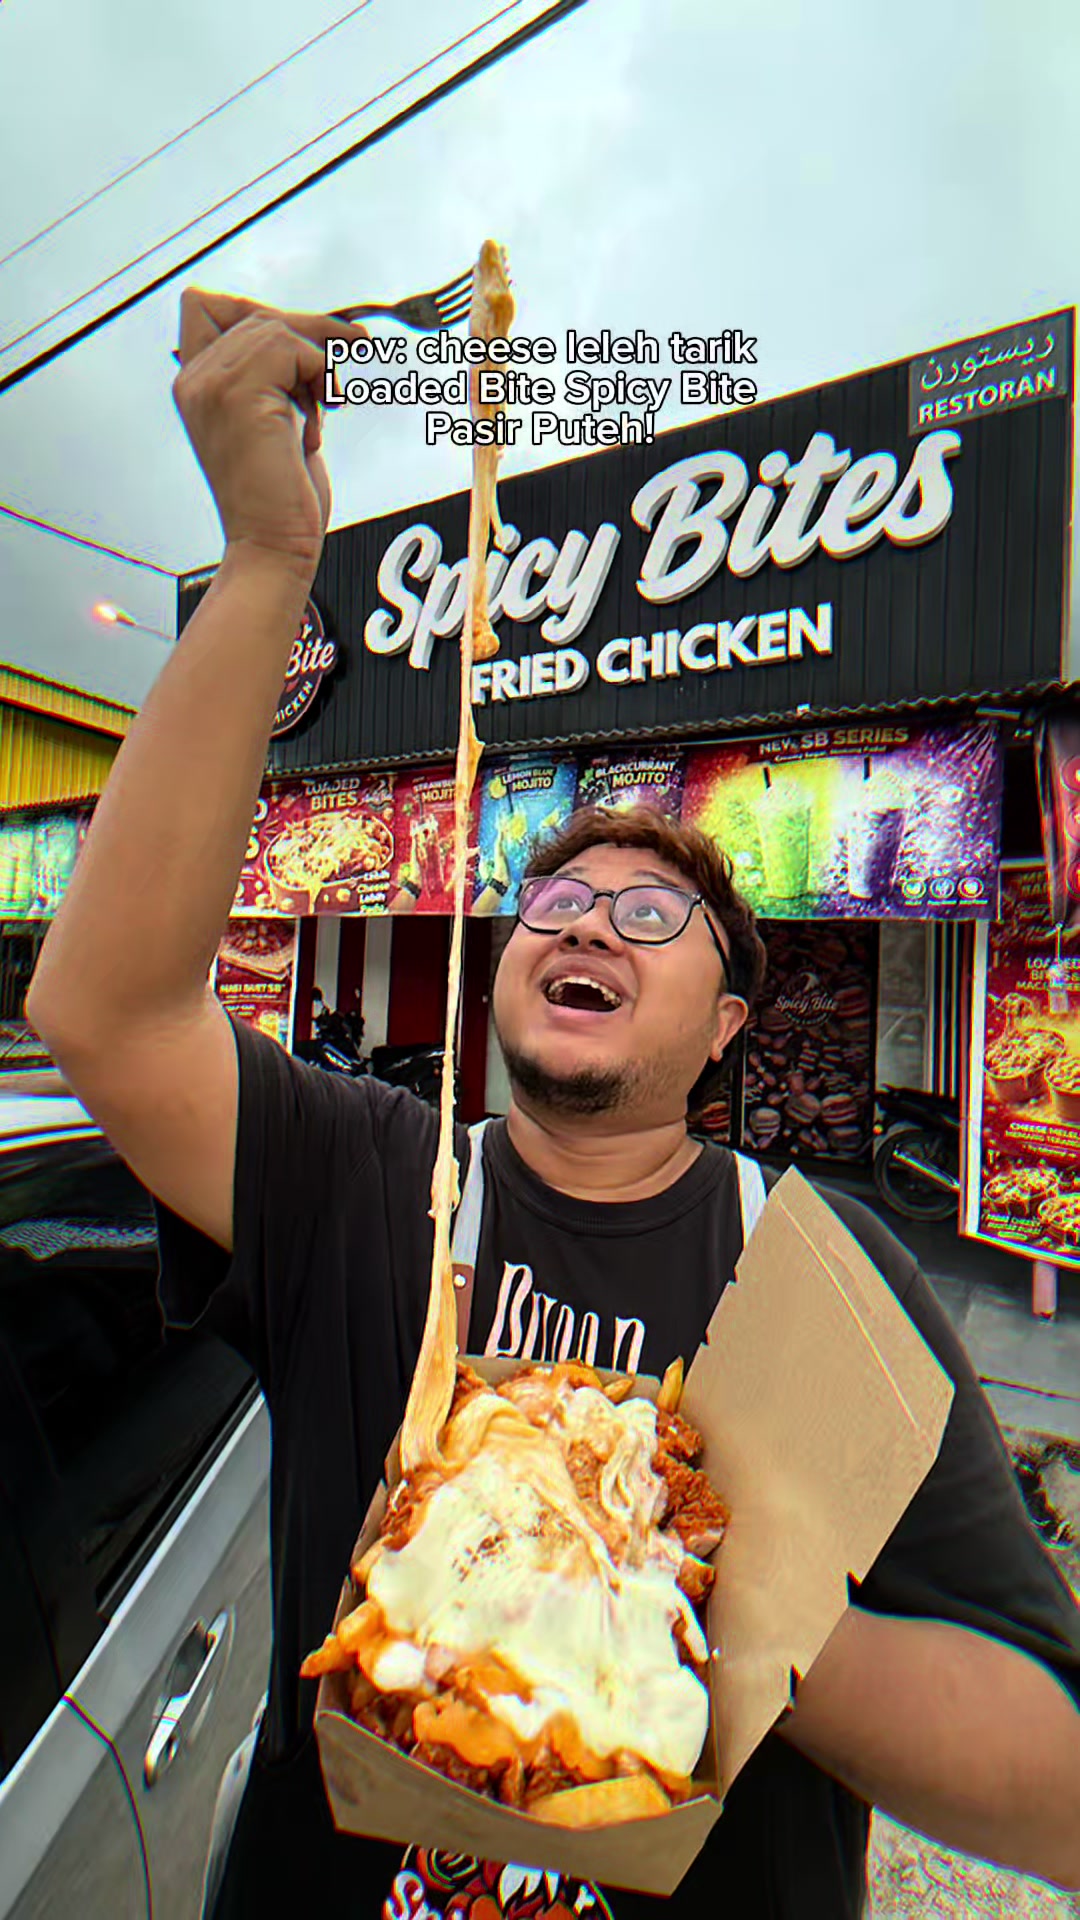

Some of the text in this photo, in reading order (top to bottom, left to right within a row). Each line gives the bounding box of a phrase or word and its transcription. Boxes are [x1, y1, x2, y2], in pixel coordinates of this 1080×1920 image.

[918, 367, 1056, 426] RESTORAN
[364, 430, 961, 670] Spicy Bites
[284, 636, 335, 680] Bite
[471, 602, 833, 705] FRIED CHICKEN
[801, 730, 830, 749] SB
[833, 727, 910, 745] SERIES
[502, 769, 532, 785] LEMON
[595, 760, 677, 779] BLACKCURRANT
[612, 771, 666, 788] MOJITO
[512, 777, 552, 792] MOJITO
[311, 790, 358, 811] BITES
[422, 788, 456, 803] MOJIT
